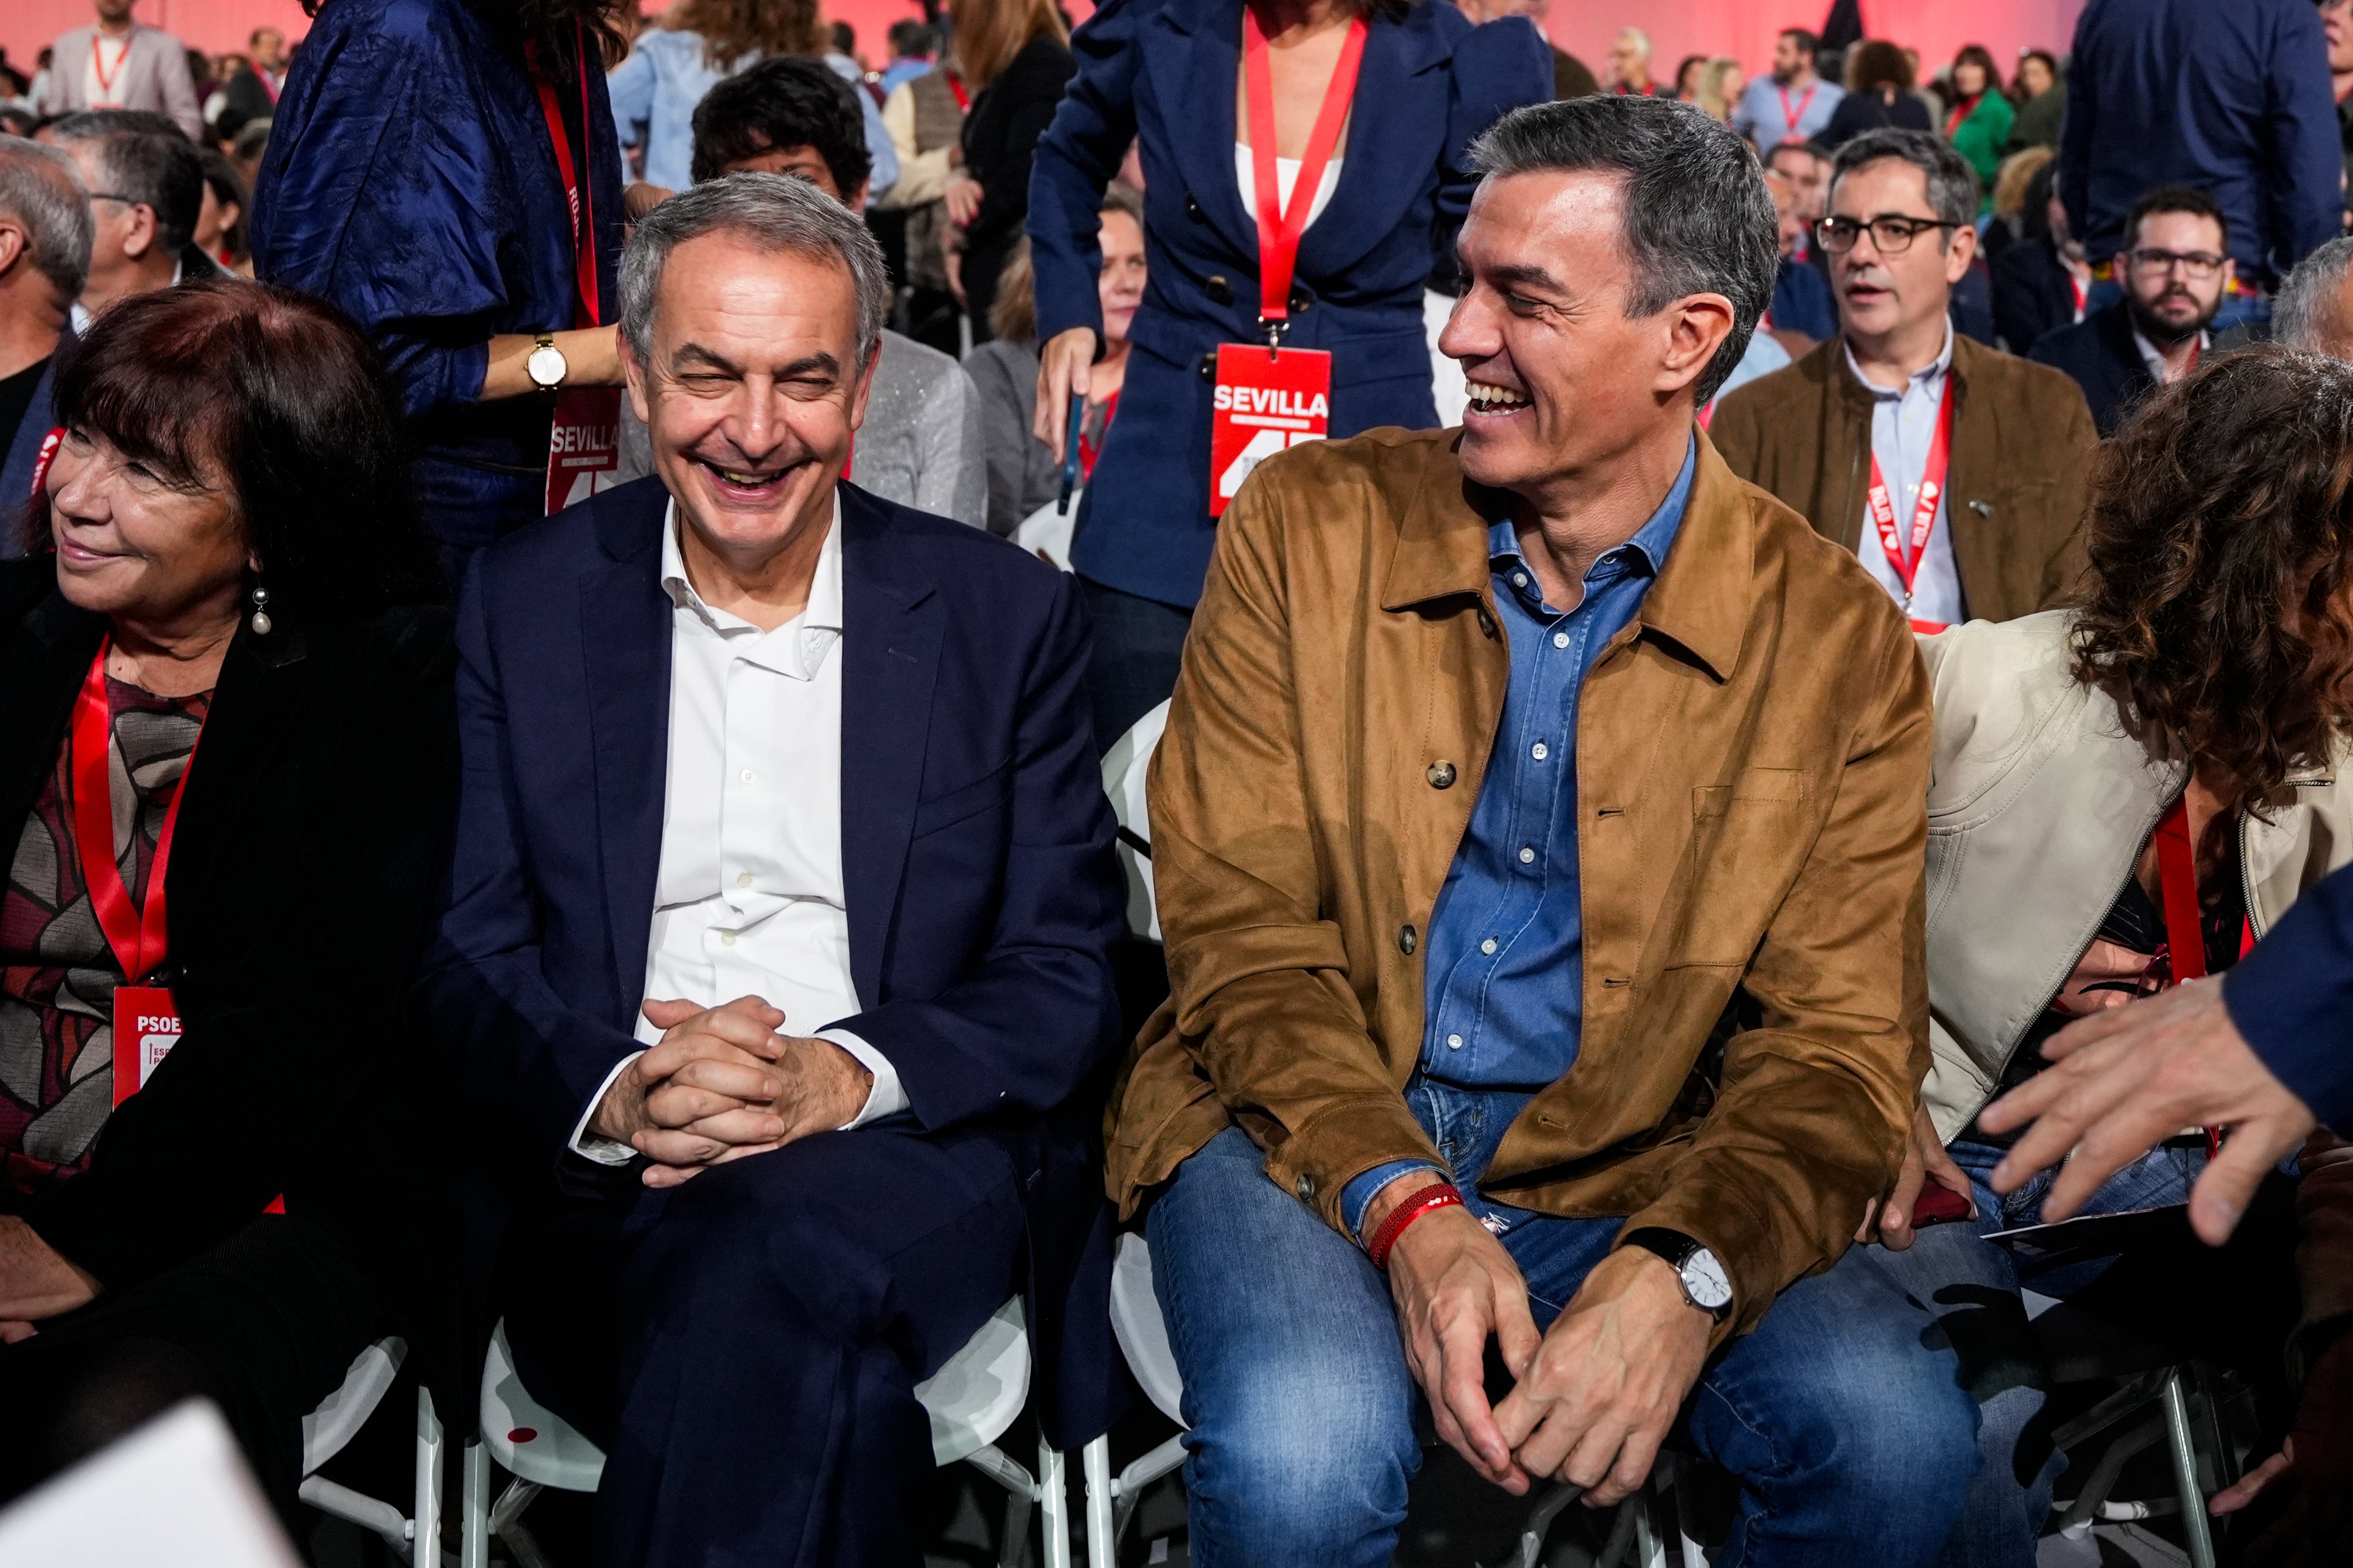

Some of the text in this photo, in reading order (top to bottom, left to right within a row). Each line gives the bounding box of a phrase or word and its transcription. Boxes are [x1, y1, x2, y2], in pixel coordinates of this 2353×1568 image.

[1213, 384, 1329, 418] SEVILLA
[552, 425, 620, 453] SEVILLA
[138, 1015, 182, 1033] PSOE
